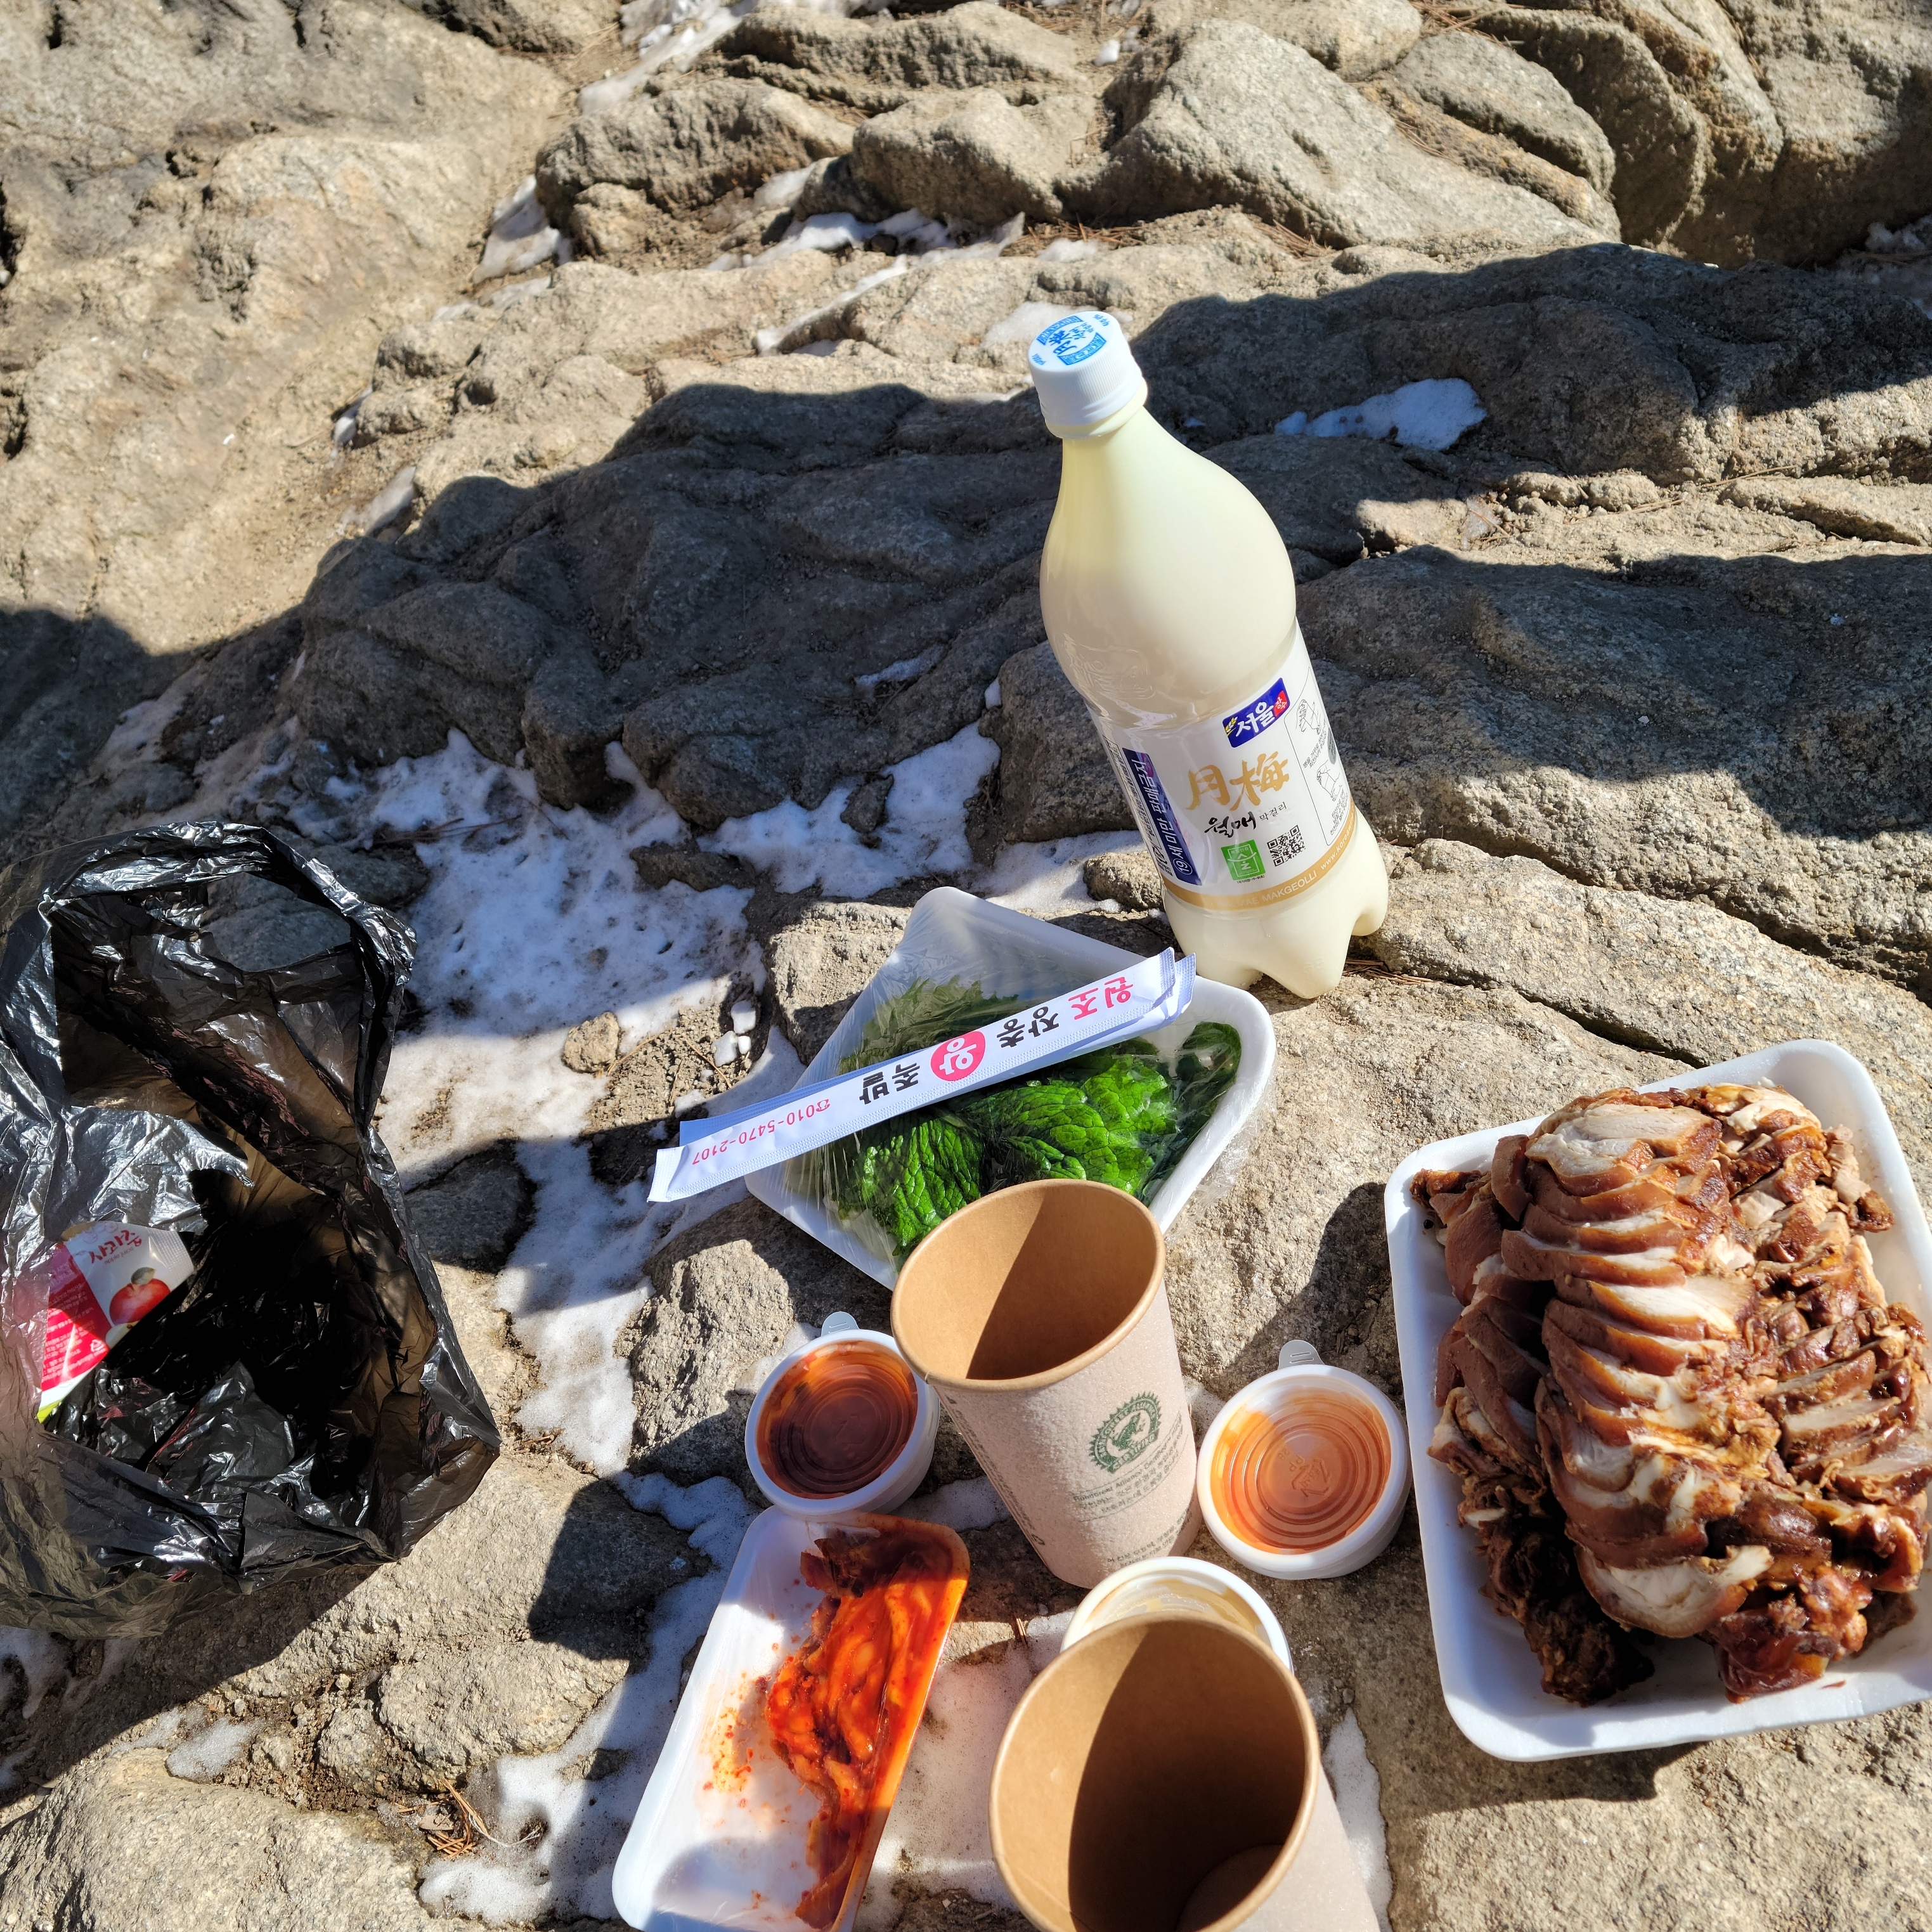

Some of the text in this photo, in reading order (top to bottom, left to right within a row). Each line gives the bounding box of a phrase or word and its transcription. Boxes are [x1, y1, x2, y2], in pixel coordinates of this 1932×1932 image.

[1236, 702, 1276, 737] 서울
[1131, 759, 1167, 814] 판매금지
[1185, 751, 1290, 810] 月梅
[1157, 818, 1177, 843] 미만
[1204, 801, 1287, 838] 월매 막걸리
[1262, 870, 1318, 902] MAKGEOLLI
[1068, 976, 1134, 1020] 원조
[997, 1006, 1060, 1048] 장충
[859, 1063, 920, 1105] 족발
[89, 1230, 141, 1264] 사과즙
[104, 1247, 134, 1264] apple juice
[1289, 1455, 1305, 1472] PP
[1073, 1486, 1113, 1502] Rainforest
[1115, 1469, 1142, 1488] Alliance
